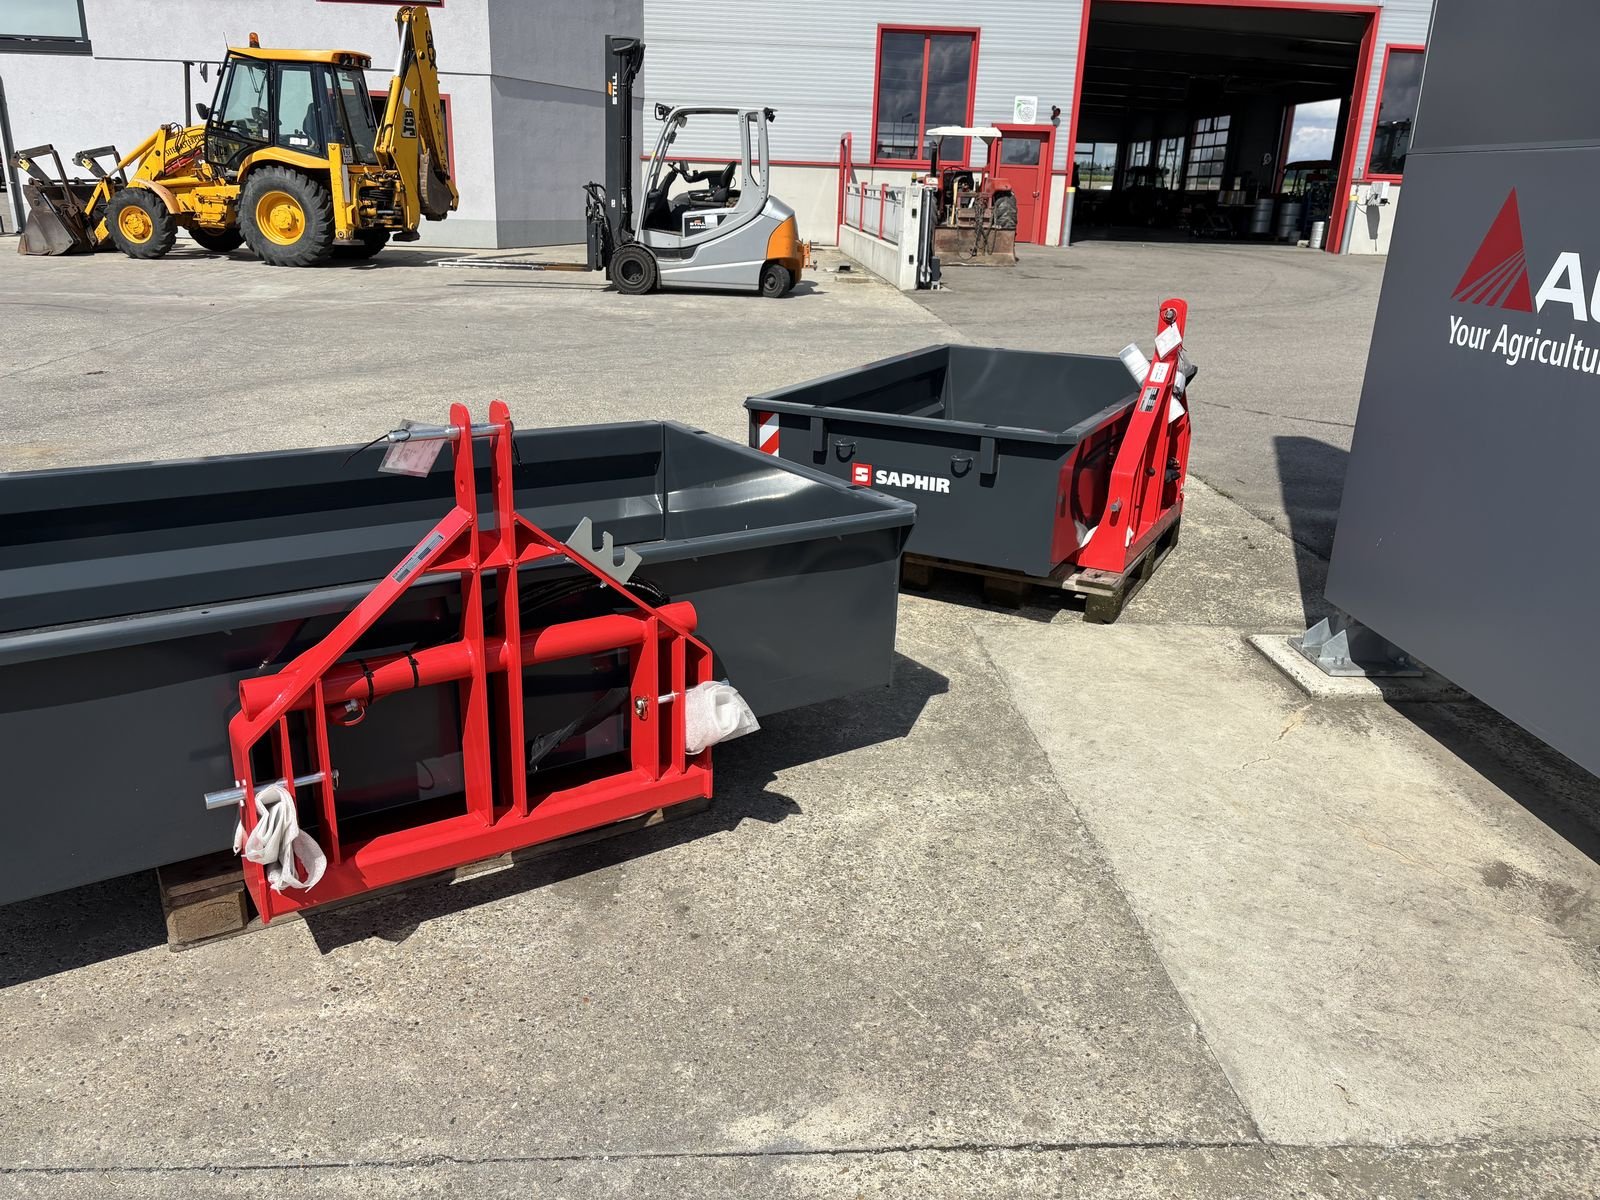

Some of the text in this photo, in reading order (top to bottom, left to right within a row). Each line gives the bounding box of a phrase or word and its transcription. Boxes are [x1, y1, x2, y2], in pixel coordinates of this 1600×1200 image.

[403, 109, 417, 137] JCB
[1535, 251, 1600, 323] A
[1449, 315, 1491, 351] Your
[875, 470, 951, 493] SAPHIR
